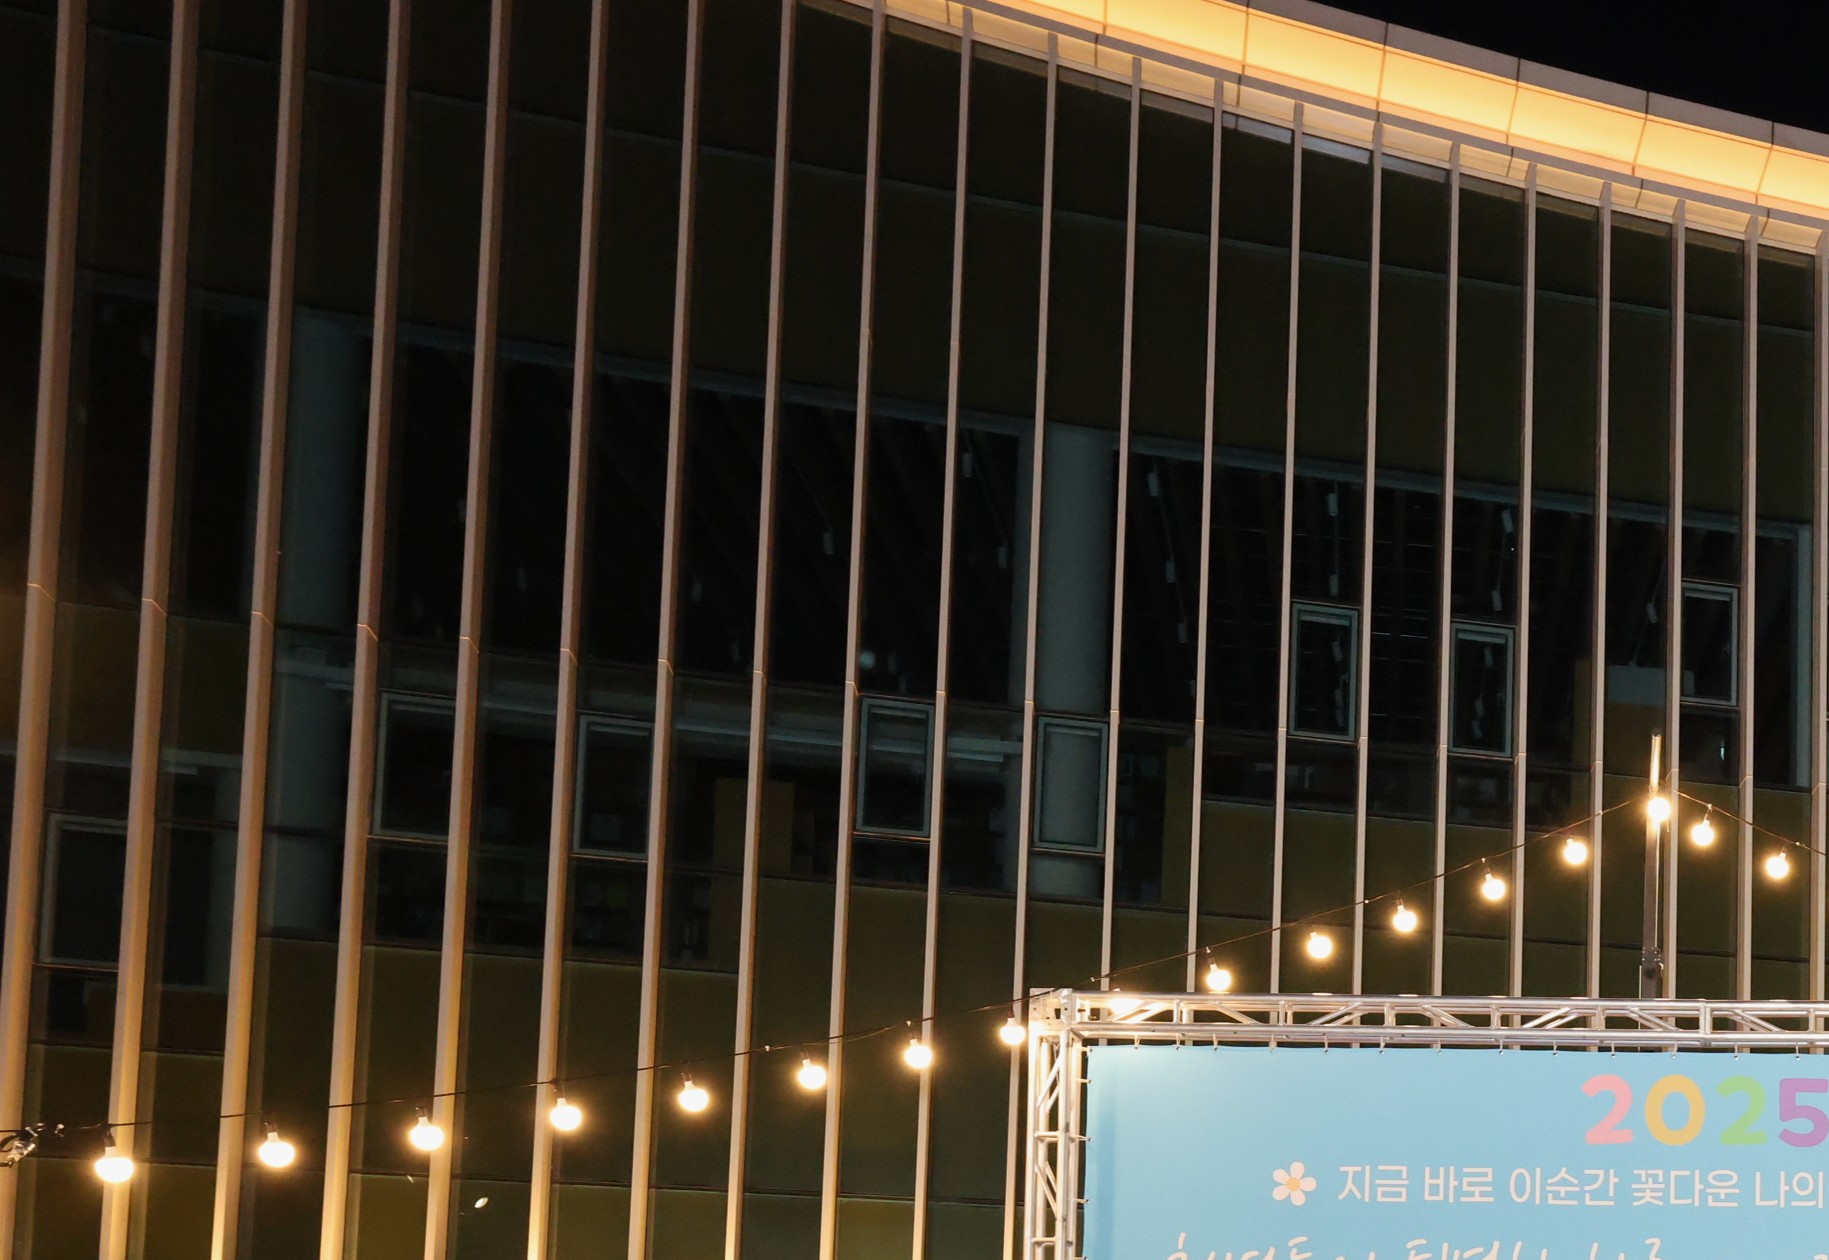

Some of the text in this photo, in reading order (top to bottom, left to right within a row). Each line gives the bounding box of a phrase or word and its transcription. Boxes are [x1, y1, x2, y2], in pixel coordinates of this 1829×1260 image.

[1581, 1073, 1829, 1147] 2025
[1339, 1165, 1409, 1203] 지금
[1423, 1167, 1495, 1203] 바로
[1509, 1167, 1618, 1206] 이순간
[1631, 1169, 1741, 1207] 꽃다운
[1754, 1171, 1824, 1208] 나의
